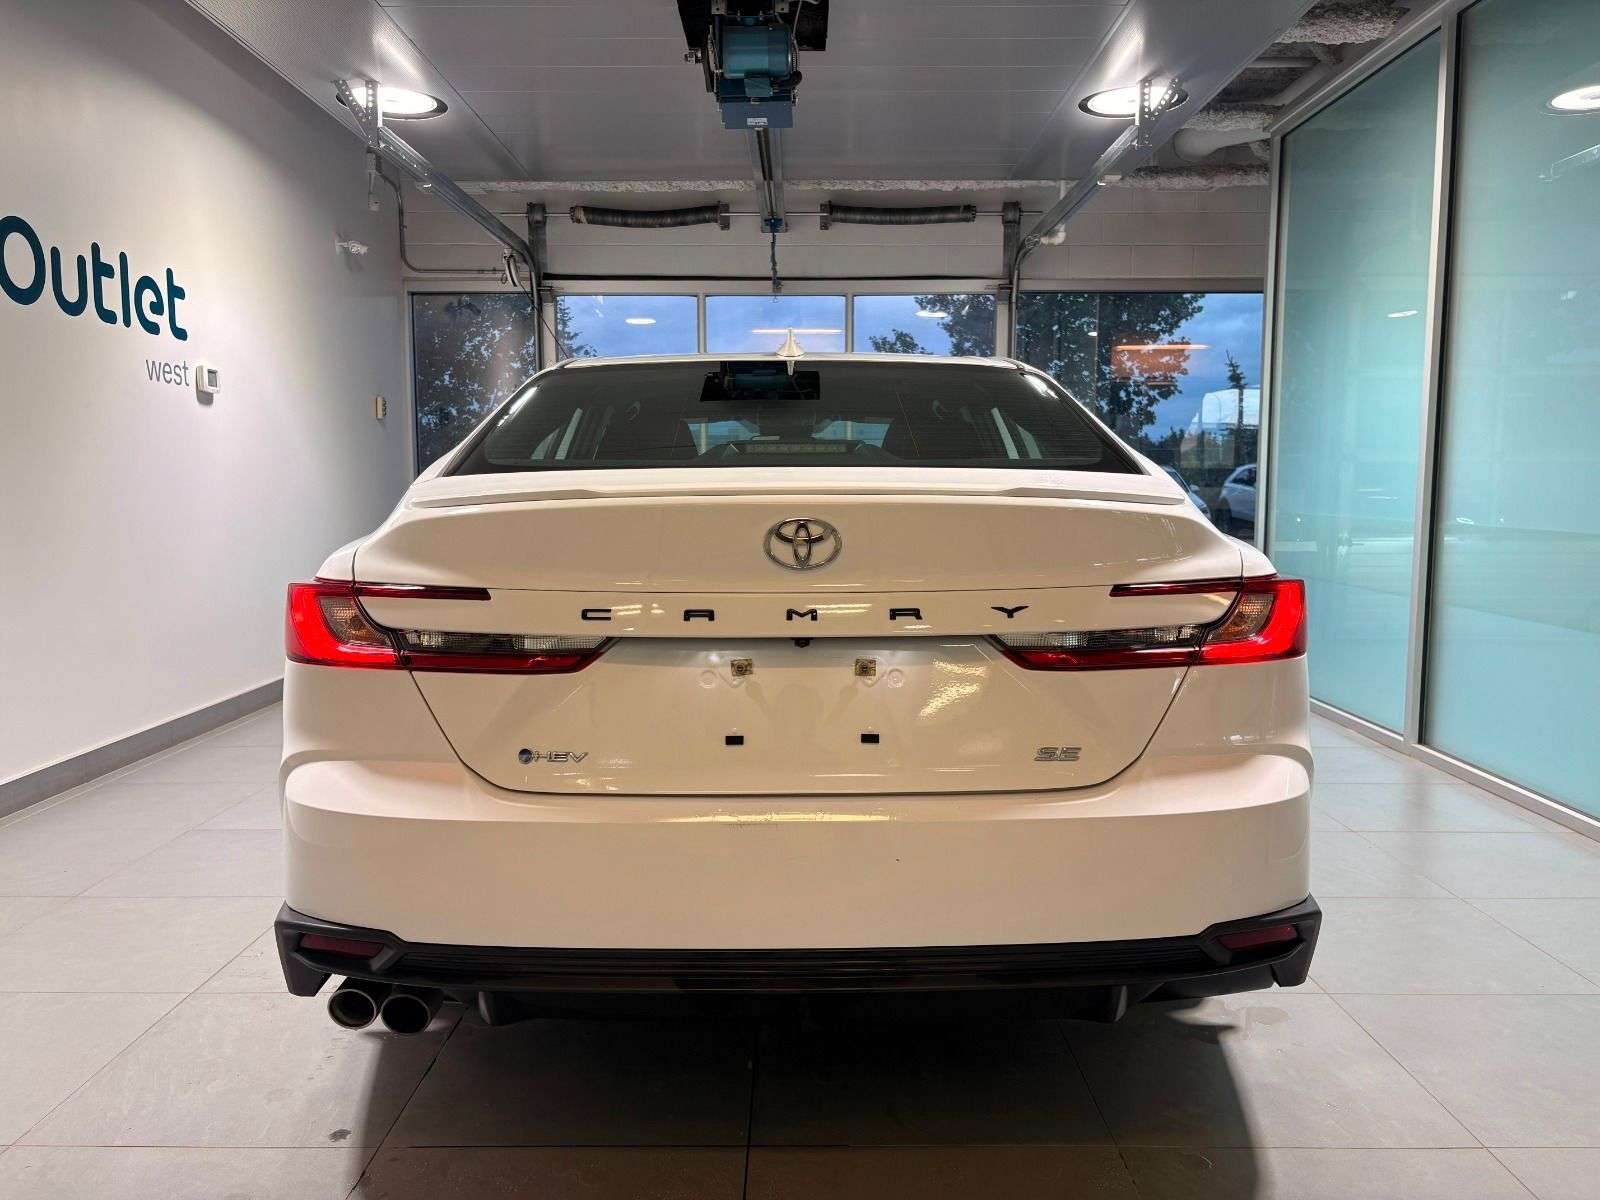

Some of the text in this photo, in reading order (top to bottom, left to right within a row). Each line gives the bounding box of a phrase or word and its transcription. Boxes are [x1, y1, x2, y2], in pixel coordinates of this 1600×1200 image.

[0, 215, 188, 341] Outlet
[145, 359, 190, 387] west
[581, 605, 1029, 621] CAMRY
[534, 751, 589, 763] HEV
[1033, 746, 1082, 761] SE
